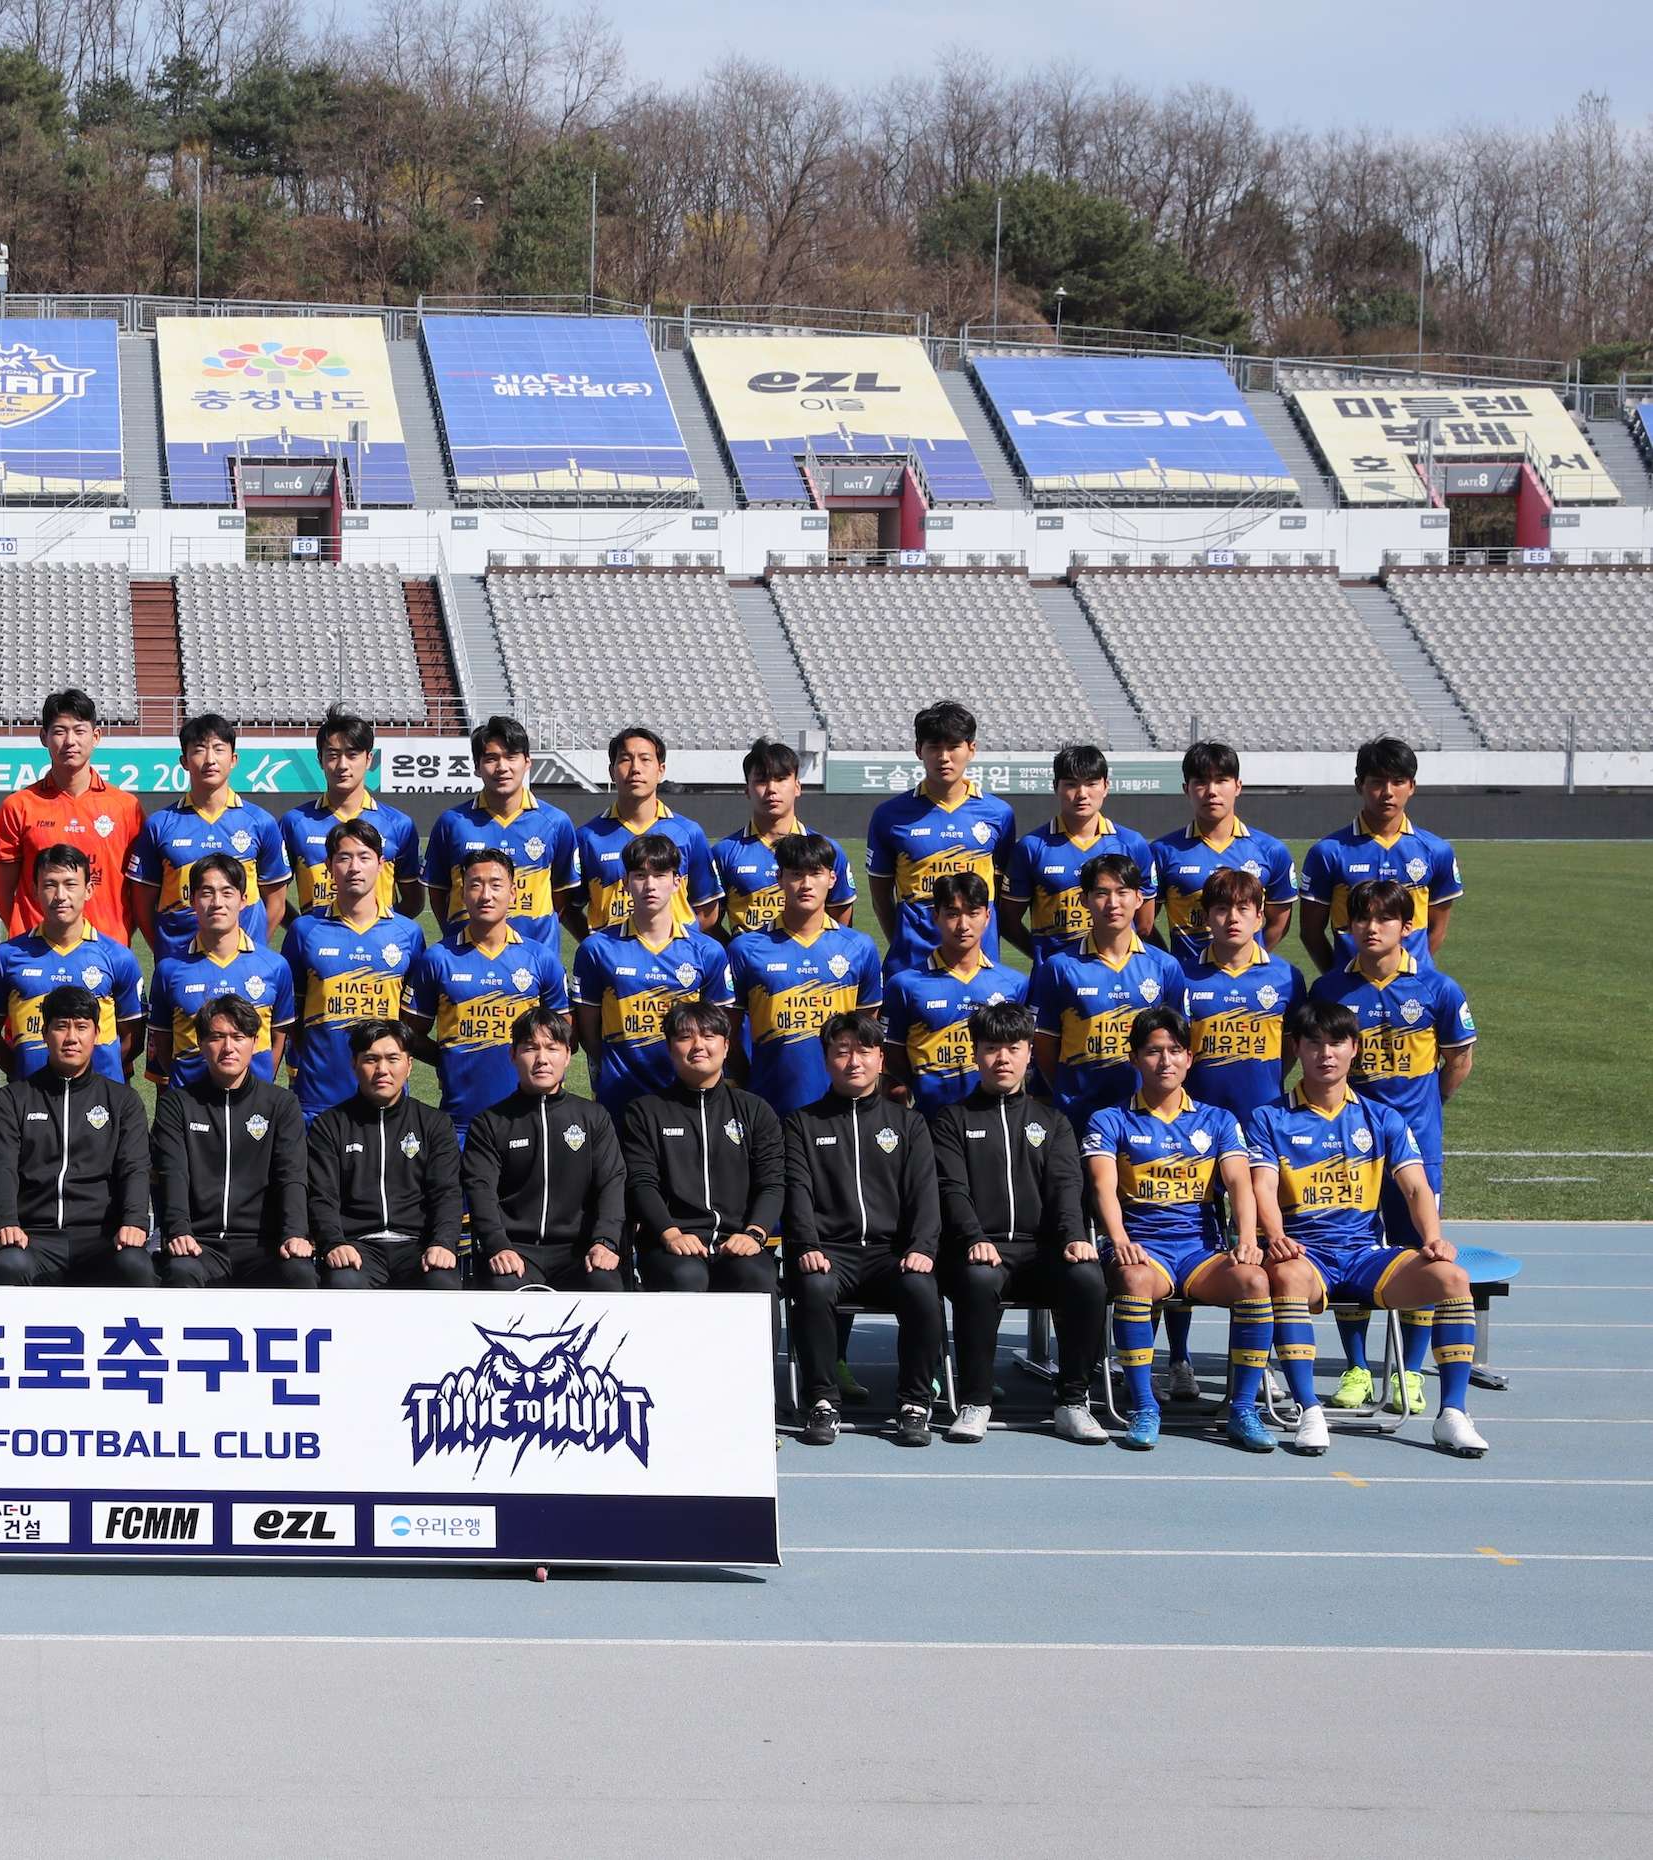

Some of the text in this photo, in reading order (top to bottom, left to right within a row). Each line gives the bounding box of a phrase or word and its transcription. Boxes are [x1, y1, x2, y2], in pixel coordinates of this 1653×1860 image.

[191, 389, 370, 410] 충청남도
[1332, 396, 1532, 418] 마들렌
[1011, 410, 1247, 427] KGM
[1350, 456, 1395, 472] 호
[1549, 454, 1589, 470] 서
[274, 475, 303, 489] GATE 6
[844, 475, 873, 489] GATE 7
[1457, 473, 1488, 487] GATE 8
[298, 541, 312, 551] E9
[612, 553, 627, 563] E8
[906, 553, 921, 563] E7
[1213, 553, 1228, 563] E6
[1529, 551, 1545, 561] E5
[391, 755, 441, 778] 온양
[327, 997, 390, 1017] 해유건설
[1137, 1180, 1205, 1202] 해유건설
[1302, 1181, 1364, 1204] 해유건설
[214, 1430, 321, 1460] CLUB
[105, 1506, 199, 1540] FCMM
[414, 1517, 481, 1537] 우리은행
